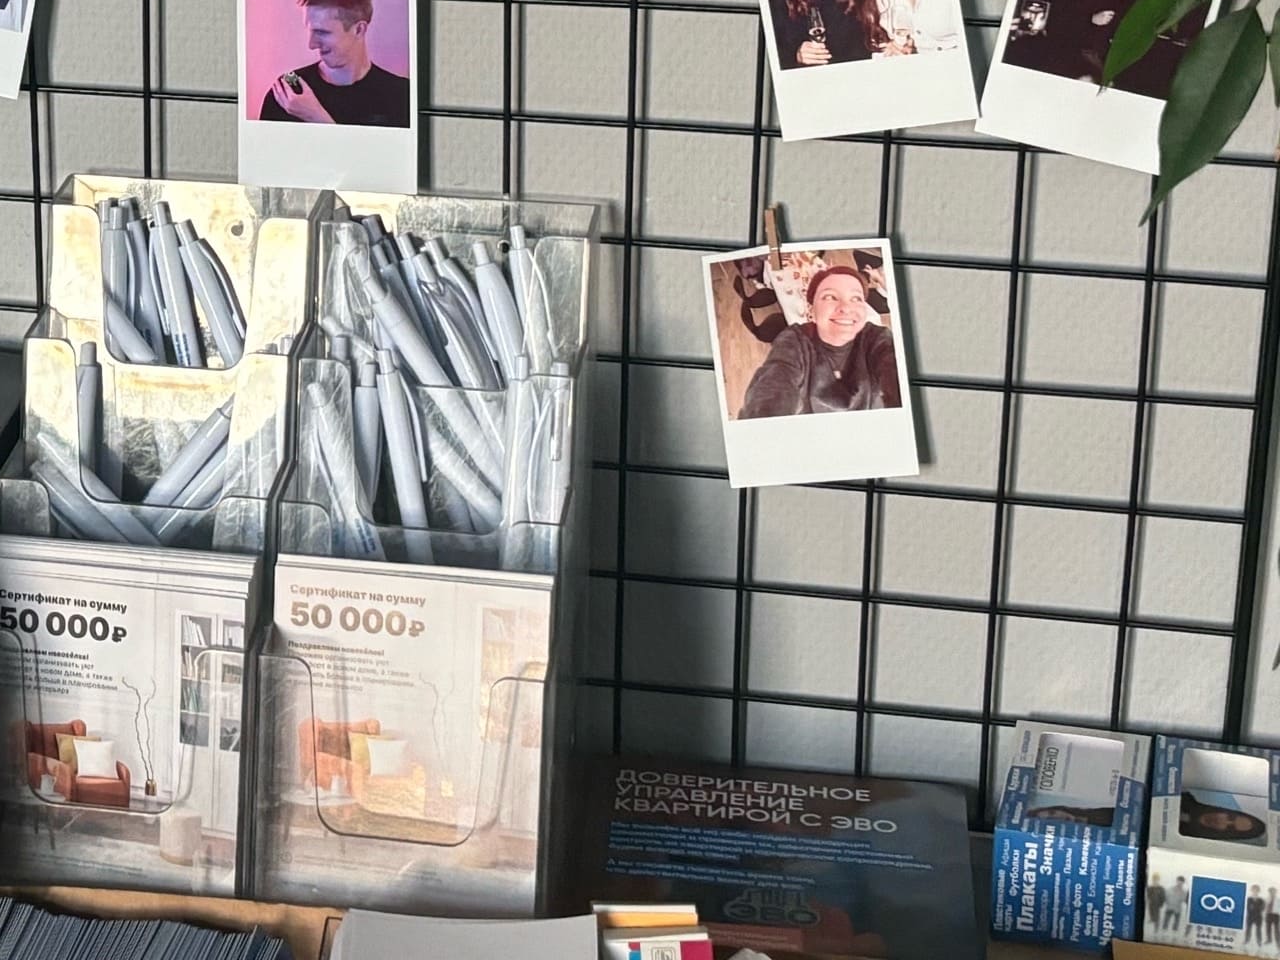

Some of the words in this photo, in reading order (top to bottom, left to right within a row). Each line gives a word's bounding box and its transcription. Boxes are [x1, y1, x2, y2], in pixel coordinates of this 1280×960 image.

[0, 589, 71, 607] Сертификат
[74, 599, 87, 608] на
[89, 600, 127, 615] сумму
[290, 584, 366, 600] Сертификат
[369, 592, 384, 602] на
[386, 594, 426, 608] сумму
[0, 605, 39, 634] 50
[290, 602, 332, 629] 50
[616, 769, 871, 802] ДОВЕРИТЕЛЬНОЕ
[616, 784, 804, 811] УПРАВЛЕНИЕ
[614, 798, 791, 826] КВАРТИРОЙ
[799, 813, 822, 827] С
[831, 815, 898, 833] ЭВО
[1041, 825, 1056, 876] Значки
[1009, 849, 1020, 897] Футболки
[1017, 841, 1039, 932] Плакаты
[1073, 883, 1082, 908] фото
[1099, 883, 1116, 946] Чертежи
